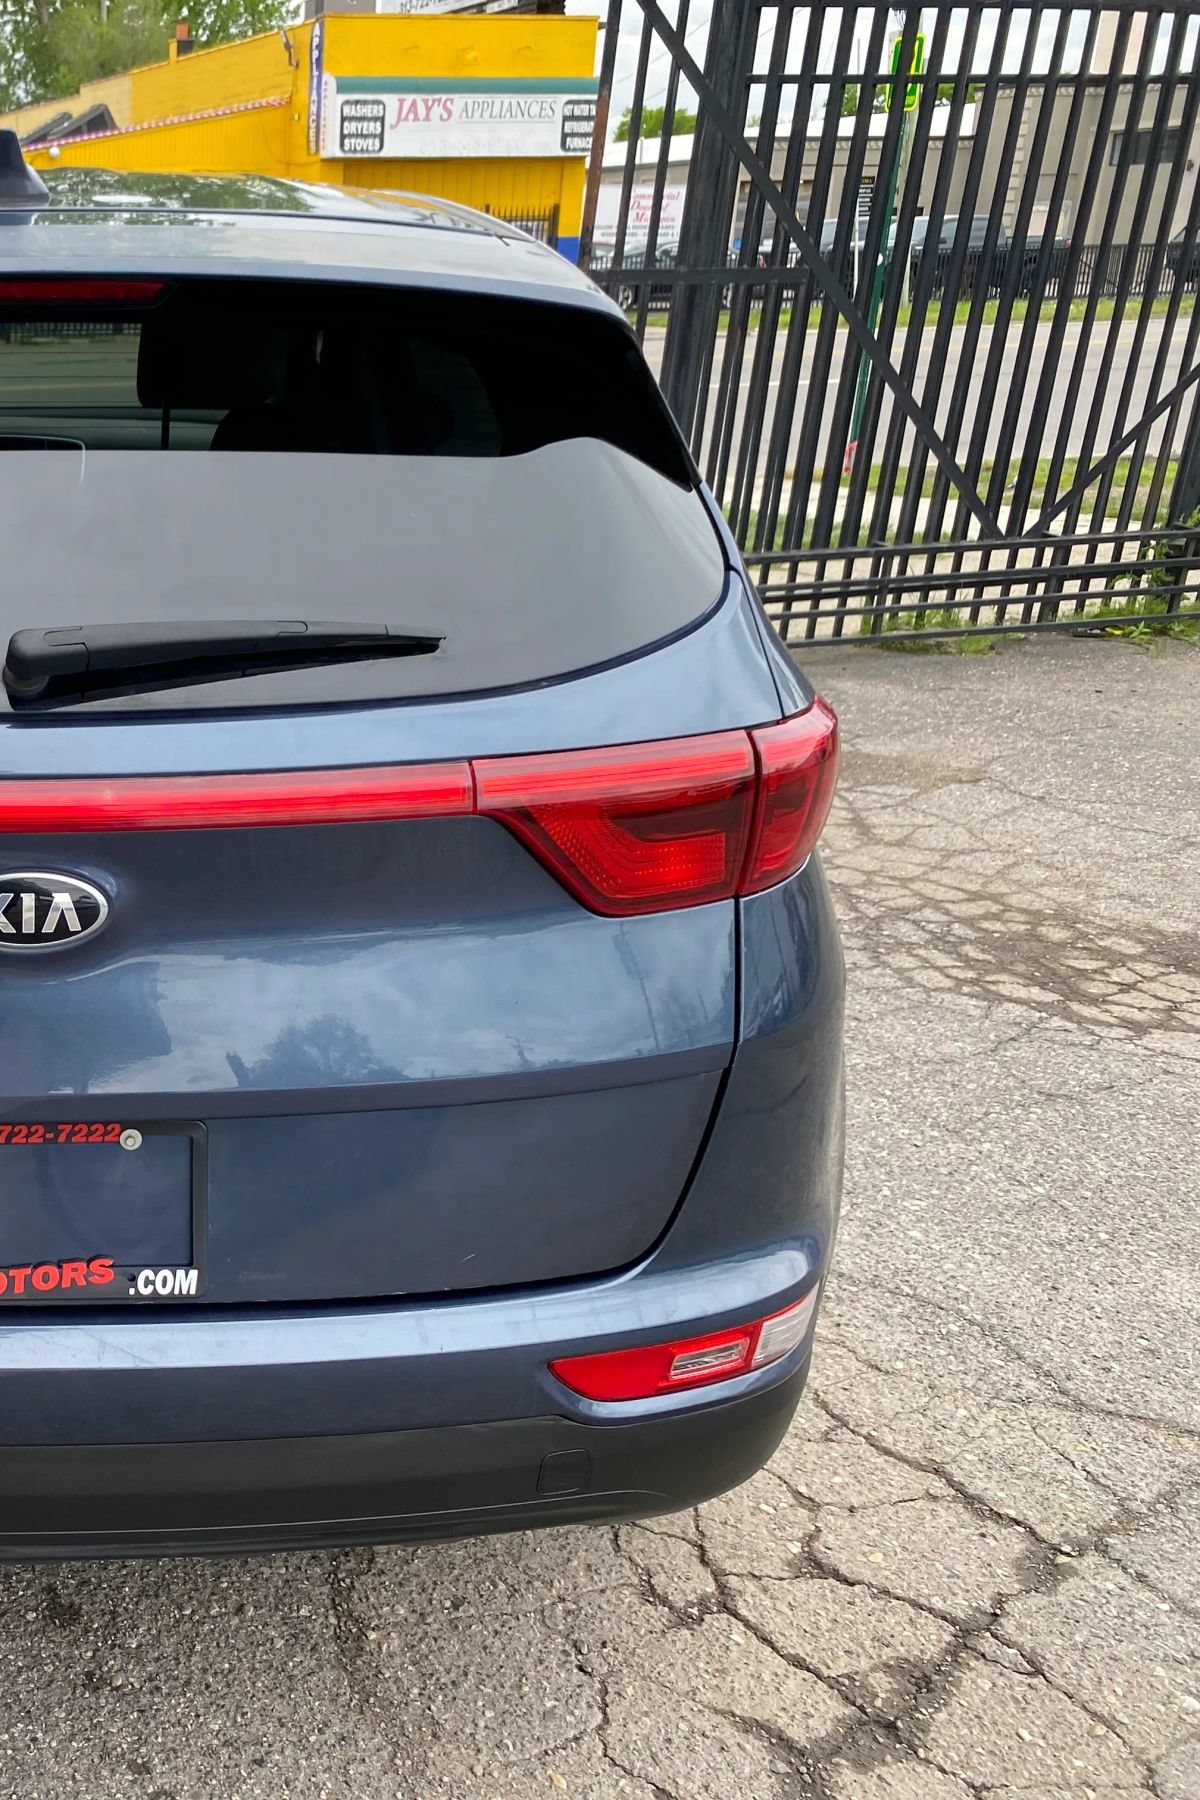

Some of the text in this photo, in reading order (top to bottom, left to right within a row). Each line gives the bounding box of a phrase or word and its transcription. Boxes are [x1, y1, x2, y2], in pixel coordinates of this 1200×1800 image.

[342, 103, 384, 118] WASHERS
[390, 97, 557, 129] JAY'S APPLIANCES
[343, 120, 382, 135] DRYERS
[343, 137, 380, 151] STOVES
[128, 1269, 199, 1296] .COM
